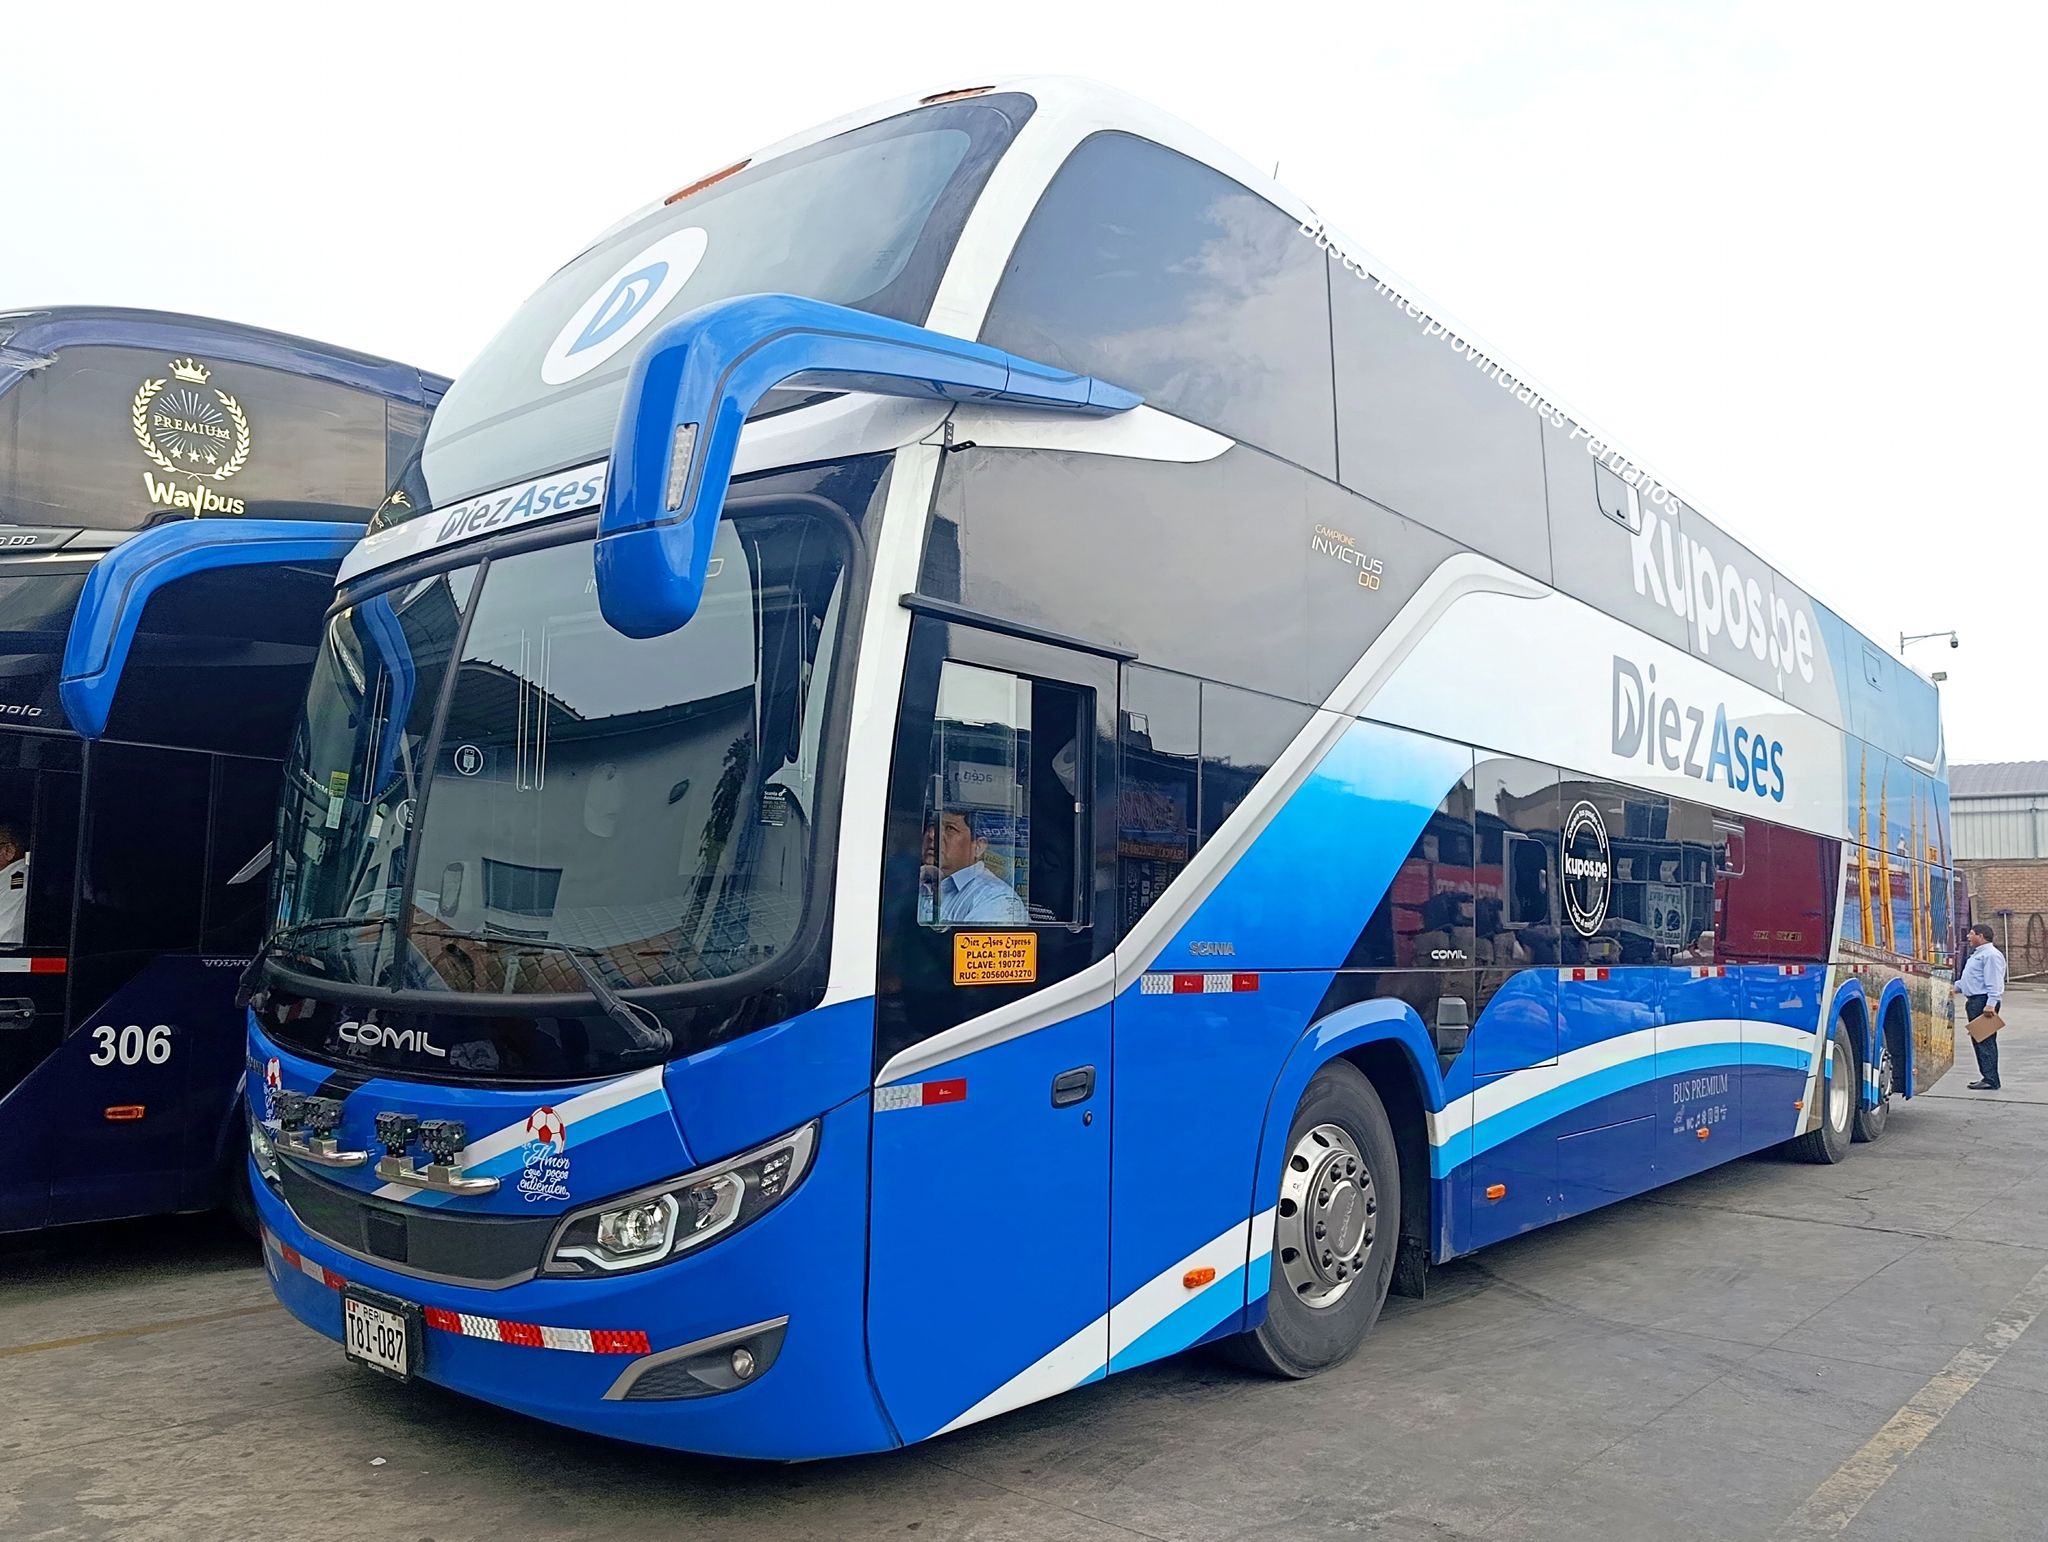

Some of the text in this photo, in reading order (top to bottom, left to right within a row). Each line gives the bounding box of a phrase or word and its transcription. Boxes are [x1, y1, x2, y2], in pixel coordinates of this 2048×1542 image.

[154, 412, 231, 440] PREMIUM
[143, 471, 245, 516] Waybus
[1315, 523, 1356, 547] CAMPIONE
[1311, 534, 1384, 575] INVICTUS
[1358, 571, 1380, 590] DD
[960, 937, 1031, 949] Diez Ases Express
[1188, 940, 1236, 956] SCANIA
[201, 959, 251, 967] VOLVO
[966, 951, 996, 959] PLACA:
[1431, 949, 1468, 960] COMIL
[966, 960, 1025, 969] CLAVE: 190727
[959, 970, 1032, 980] RUC: 20560043270
[89, 1024, 173, 1067] 306
[338, 1021, 446, 1057] COMIL
[1673, 1073, 1728, 1104] BUS PREMIUM
[522, 1142, 570, 1172] Amor
[523, 1167, 569, 1183] que pocos
